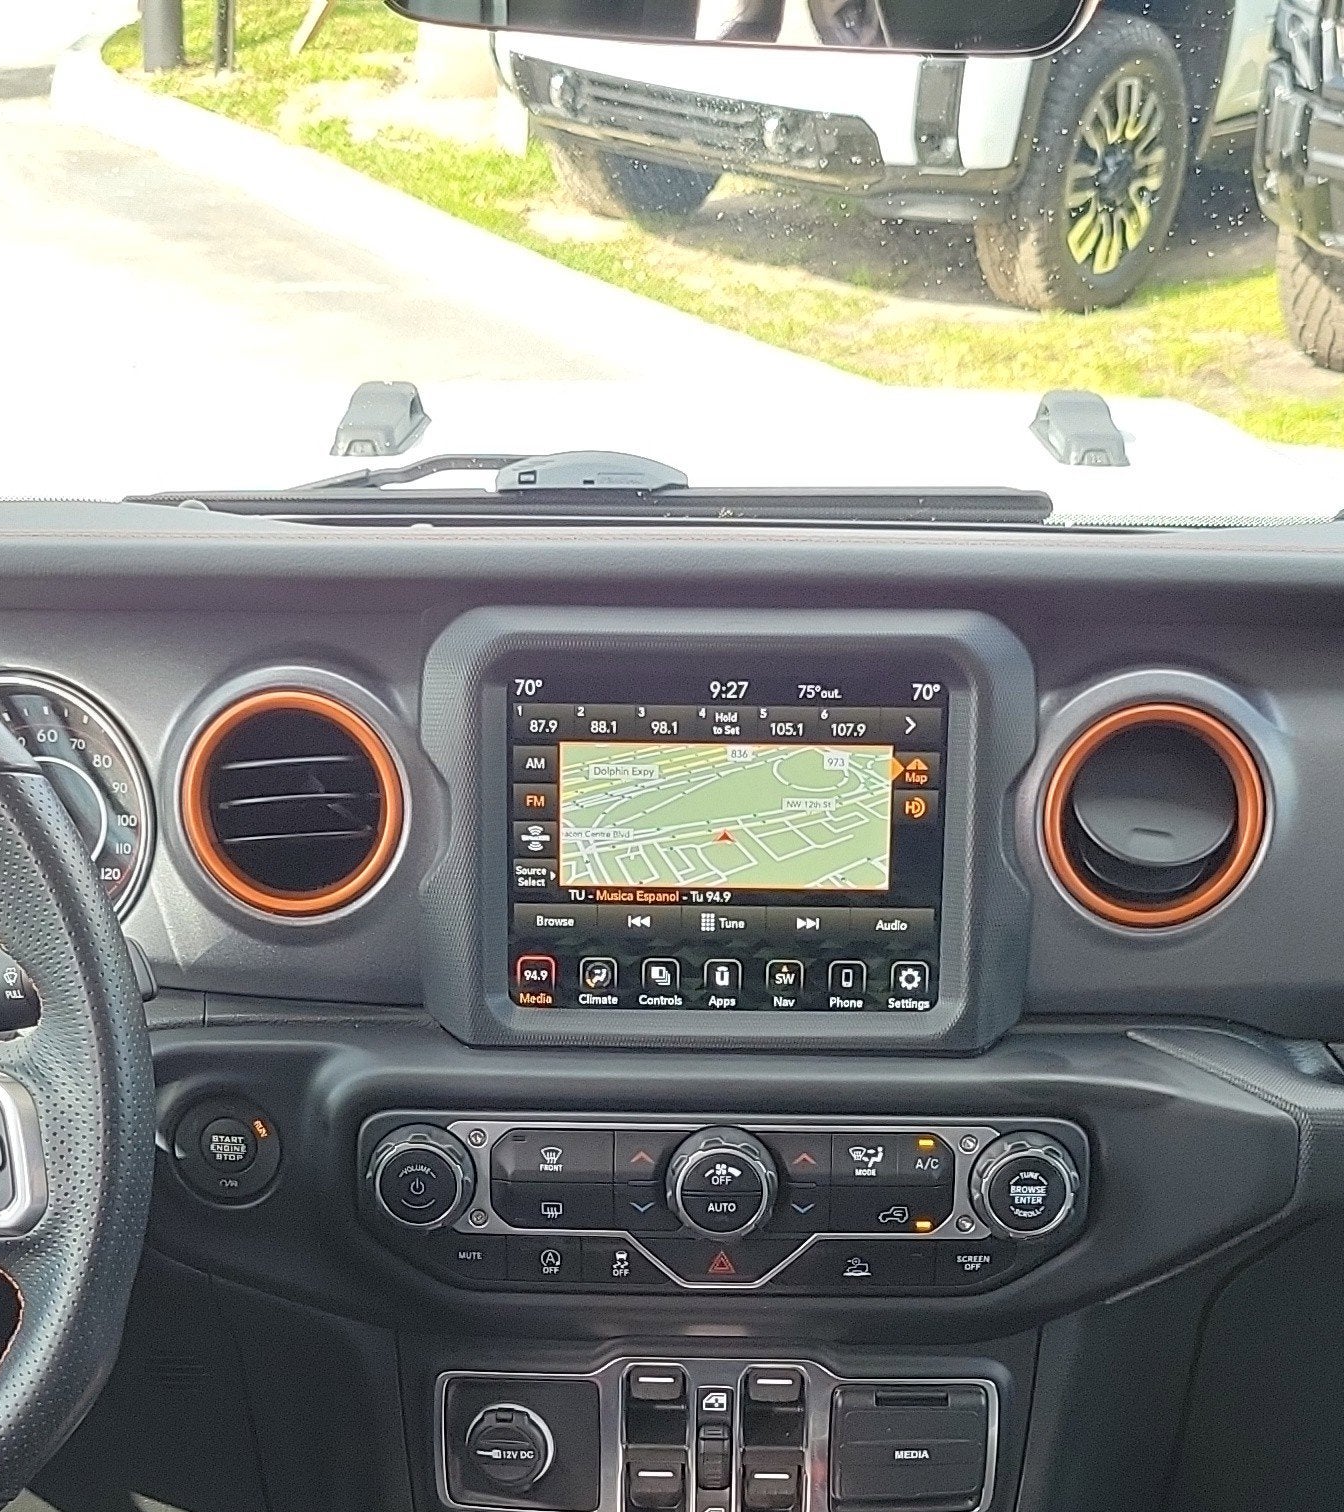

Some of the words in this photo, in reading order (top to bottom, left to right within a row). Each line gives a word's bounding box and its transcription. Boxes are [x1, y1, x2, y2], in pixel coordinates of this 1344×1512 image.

[709, 681, 749, 699] 9:27
[516, 705, 523, 717] 1
[576, 706, 585, 717] 2
[637, 706, 646, 718] 3
[698, 707, 706, 718] 4
[759, 708, 767, 719] 5
[820, 709, 829, 720] 6
[715, 712, 738, 723] Hold
[529, 719, 558, 733] 87.9
[590, 720, 617, 734] 88.1
[650, 720, 679, 735] 98.1
[713, 725, 723, 735] to
[724, 725, 740, 736] Set
[770, 722, 804, 736] 105.1
[830, 723, 867, 737] 107.9
[36, 729, 58, 743] 60
[69, 738, 86, 750] 70
[730, 749, 748, 759] 836
[92, 754, 113, 768] 80
[525, 757, 546, 770] AM
[827, 757, 845, 767] 973
[593, 766, 629, 778] Dolphin
[631, 766, 654, 779] Expy
[905, 772, 928, 784] Map
[112, 782, 128, 794] 90
[525, 795, 545, 807] FM
[786, 800, 802, 808] NW
[804, 800, 822, 808] 12th
[116, 815, 138, 827] 100
[612, 830, 630, 838] Blvd
[115, 843, 132, 855] 110
[100, 868, 121, 880] 120
[515, 866, 547, 876] Source
[517, 877, 546, 887] Select
[568, 889, 585, 900] TU
[596, 890, 634, 901] Musica
[636, 890, 679, 903] Espanol
[690, 891, 703, 902] Tu
[706, 891, 731, 902] 94.9
[536, 916, 575, 927] Browse
[719, 917, 745, 929] Tune
[875, 919, 908, 931] Audio
[523, 970, 548, 981] 94.9
[774, 973, 795, 985] SW
[519, 993, 553, 1004] Media
[578, 993, 618, 1005] Climate
[638, 994, 683, 1006] Controls
[708, 996, 736, 1009] Apps
[773, 997, 795, 1008] Nav
[829, 997, 864, 1009] Phone
[888, 998, 930, 1011] Settings
[211, 1134, 244, 1144] START
[210, 1143, 247, 1153] ENGINE
[216, 1153, 244, 1161] STOP
[403, 1164, 431, 1175] VOLUME
[539, 1163, 564, 1172] FRONT
[915, 1159, 940, 1171] A/C
[855, 1169, 877, 1177] MODE
[711, 1175, 732, 1185] OFF
[1010, 1185, 1047, 1194] BROWSE
[1014, 1196, 1043, 1204] ENTER
[707, 1202, 736, 1213] AUTO
[458, 1251, 483, 1260] MUTE
[956, 1255, 991, 1263] SCREEN
[542, 1266, 559, 1275] OFF
[612, 1268, 630, 1277] OFF
[964, 1263, 981, 1271] OFF
[503, 1450, 519, 1459] 12V
[520, 1450, 534, 1459] DC
[894, 1449, 930, 1460] MEDIA
